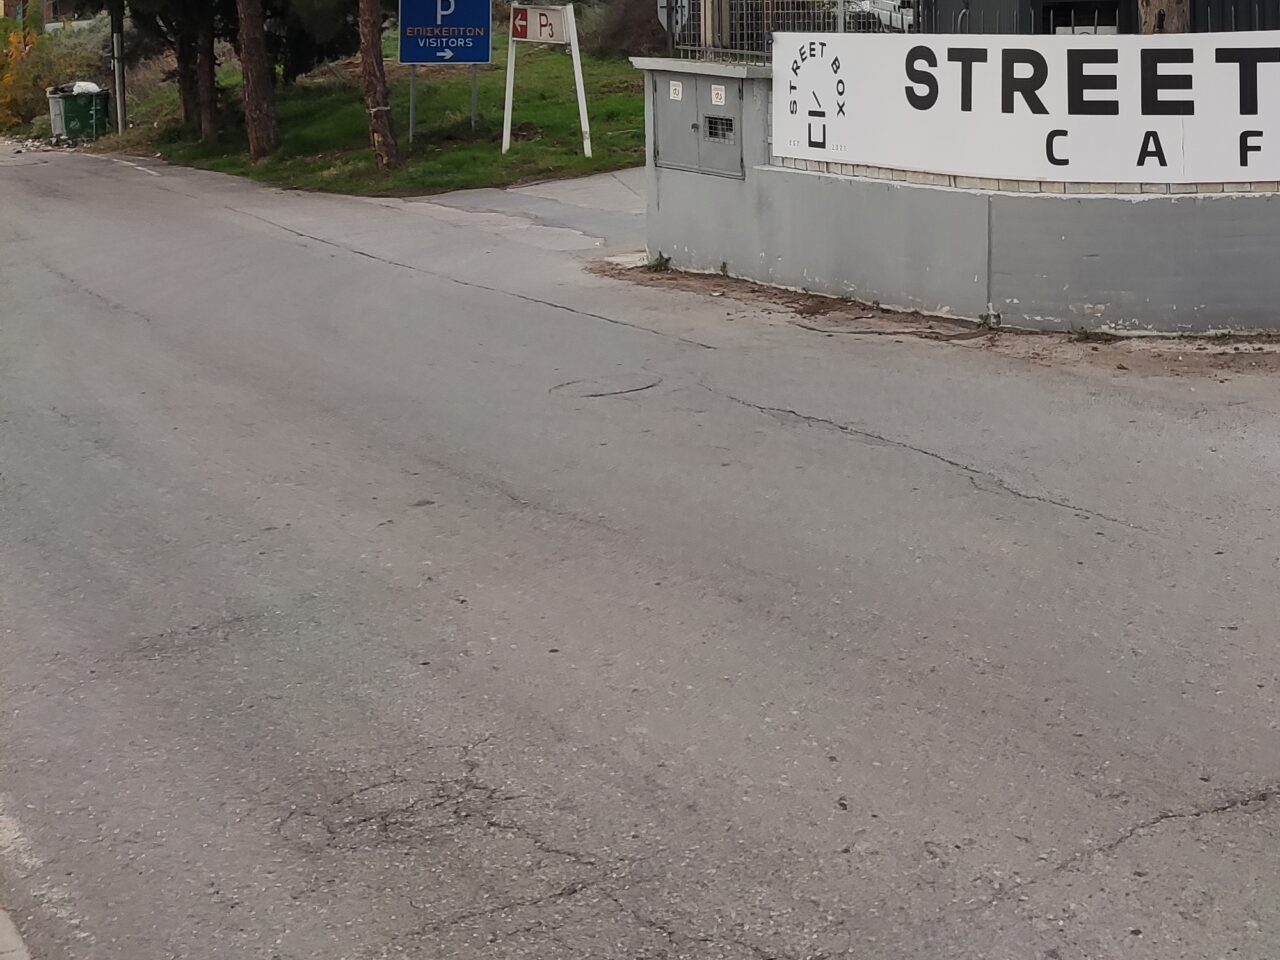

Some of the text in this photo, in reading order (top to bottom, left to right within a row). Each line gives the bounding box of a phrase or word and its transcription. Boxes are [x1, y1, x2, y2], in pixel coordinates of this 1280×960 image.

[406, 27, 484, 37] ΕΠΙΣΚΕΠΤΩΝ
[418, 38, 473, 48] VISITORS
[789, 42, 846, 118] STREET BOX
